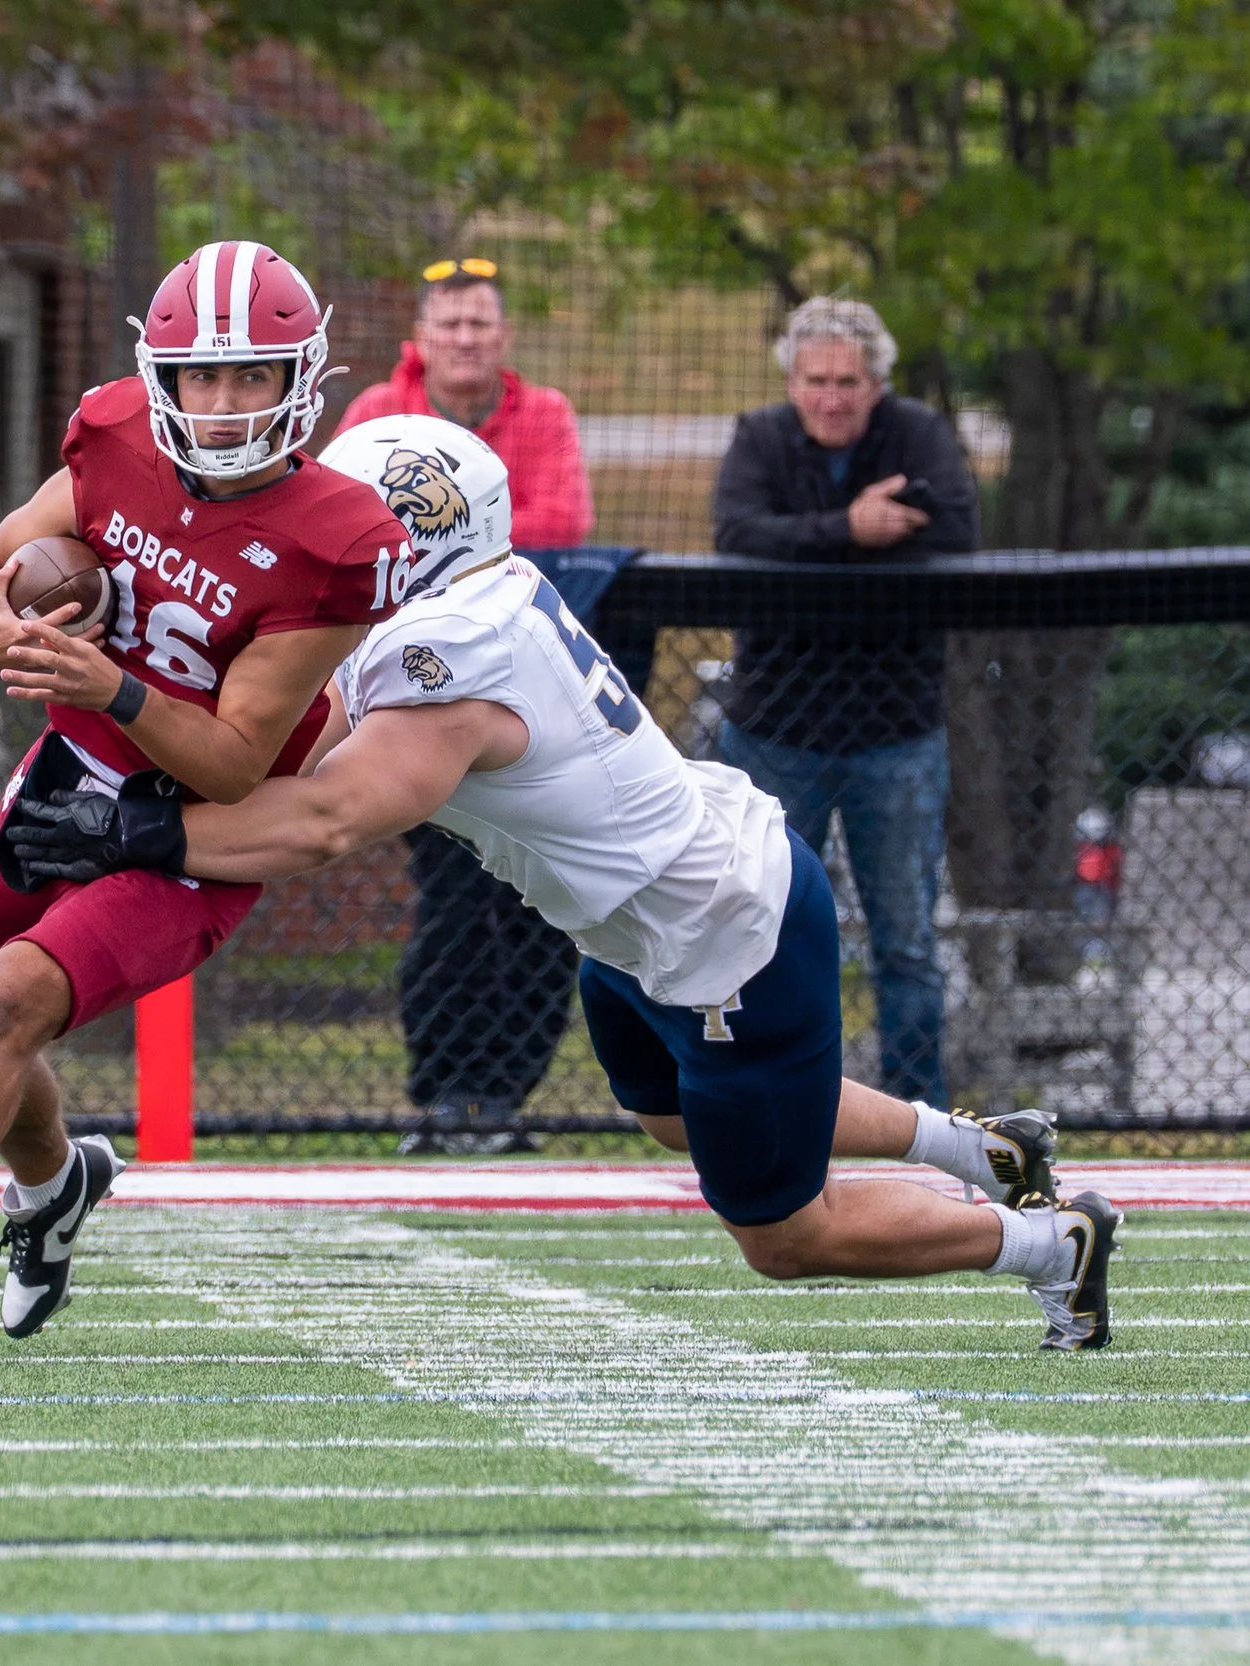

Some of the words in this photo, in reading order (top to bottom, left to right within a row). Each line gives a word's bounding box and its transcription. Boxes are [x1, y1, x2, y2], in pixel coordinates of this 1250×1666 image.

[215, 452, 240, 461] Riddell
[103, 510, 238, 617] BOBCATS
[370, 540, 413, 610] 16
[109, 559, 217, 690] 16
